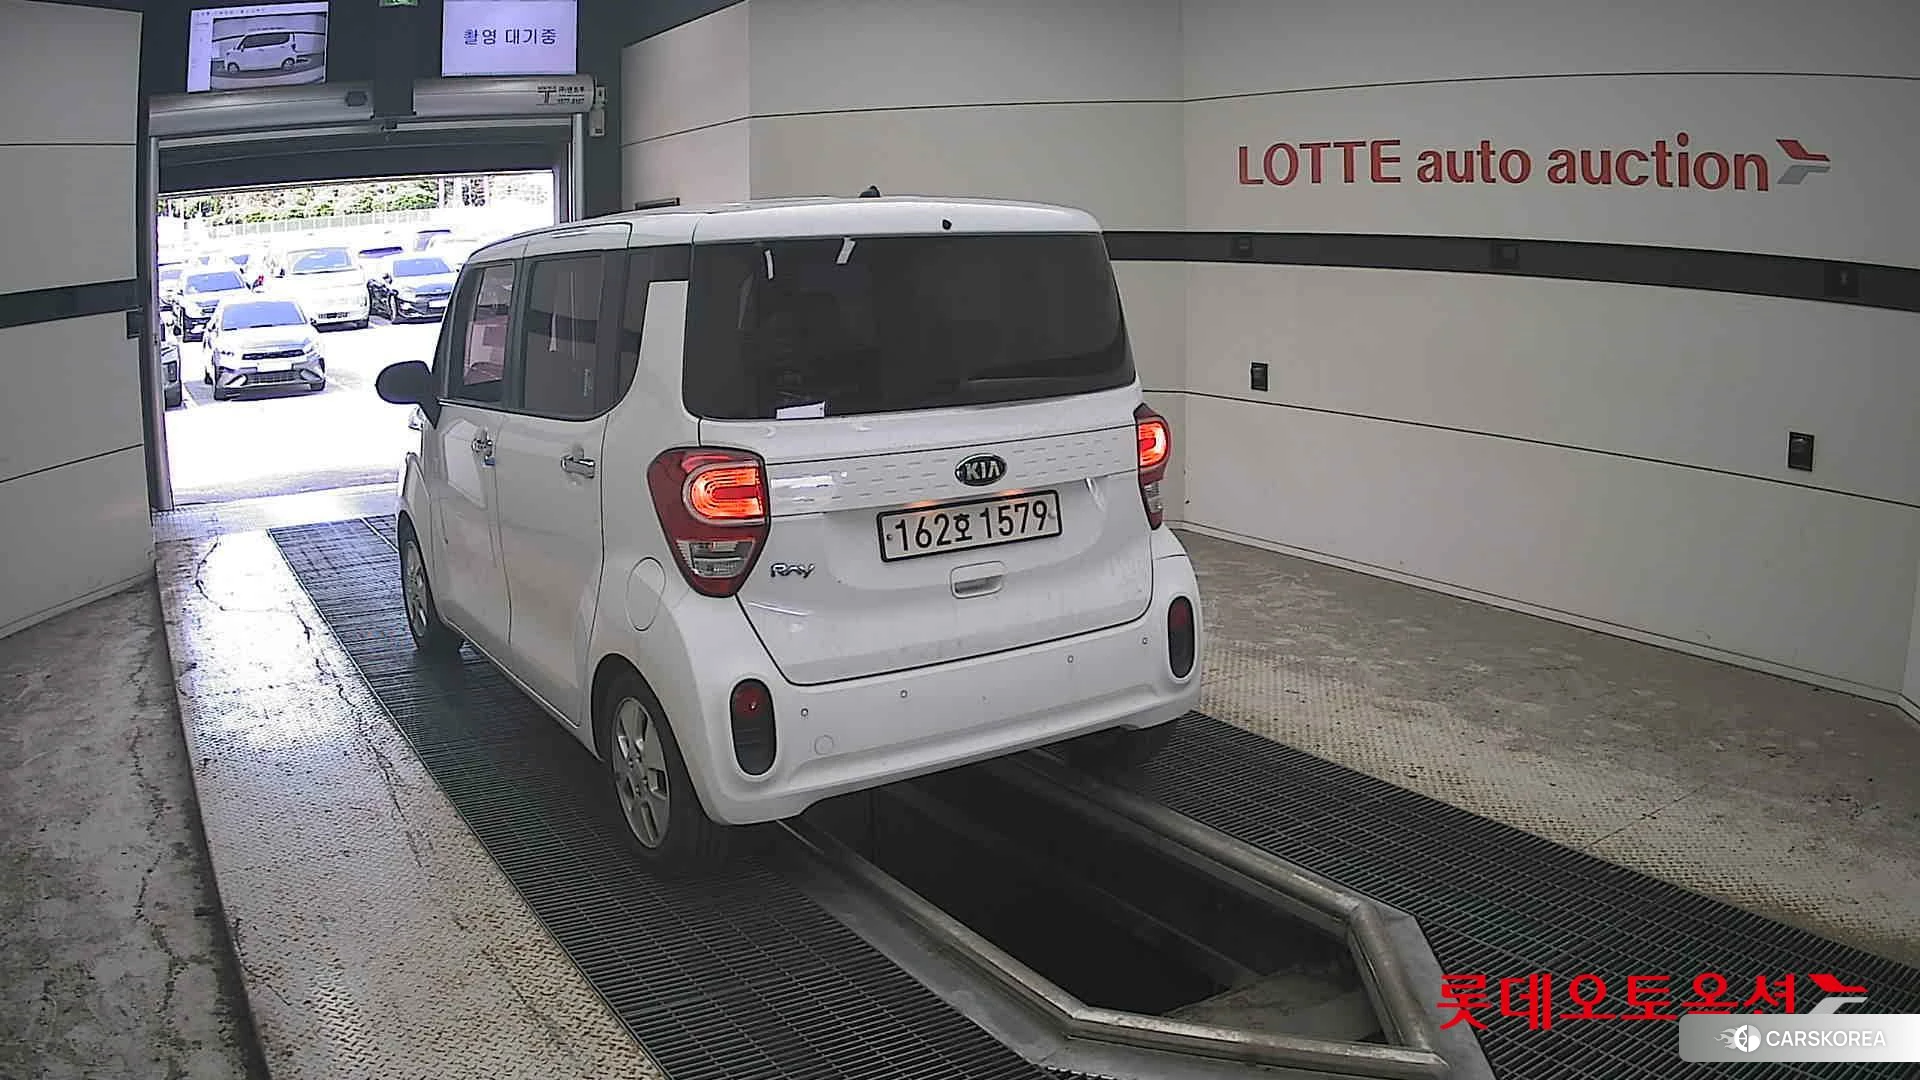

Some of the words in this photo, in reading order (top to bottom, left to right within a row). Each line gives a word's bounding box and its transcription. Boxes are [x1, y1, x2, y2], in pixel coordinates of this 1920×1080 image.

[505, 28, 557, 45] 대기중
[1238, 139, 1401, 186] LOTTE
[1416, 139, 1532, 184] auto
[1547, 131, 1769, 192] auction
[965, 460, 1001, 481] KIA
[895, 513, 972, 551] 162호
[979, 500, 1048, 539] 1579
